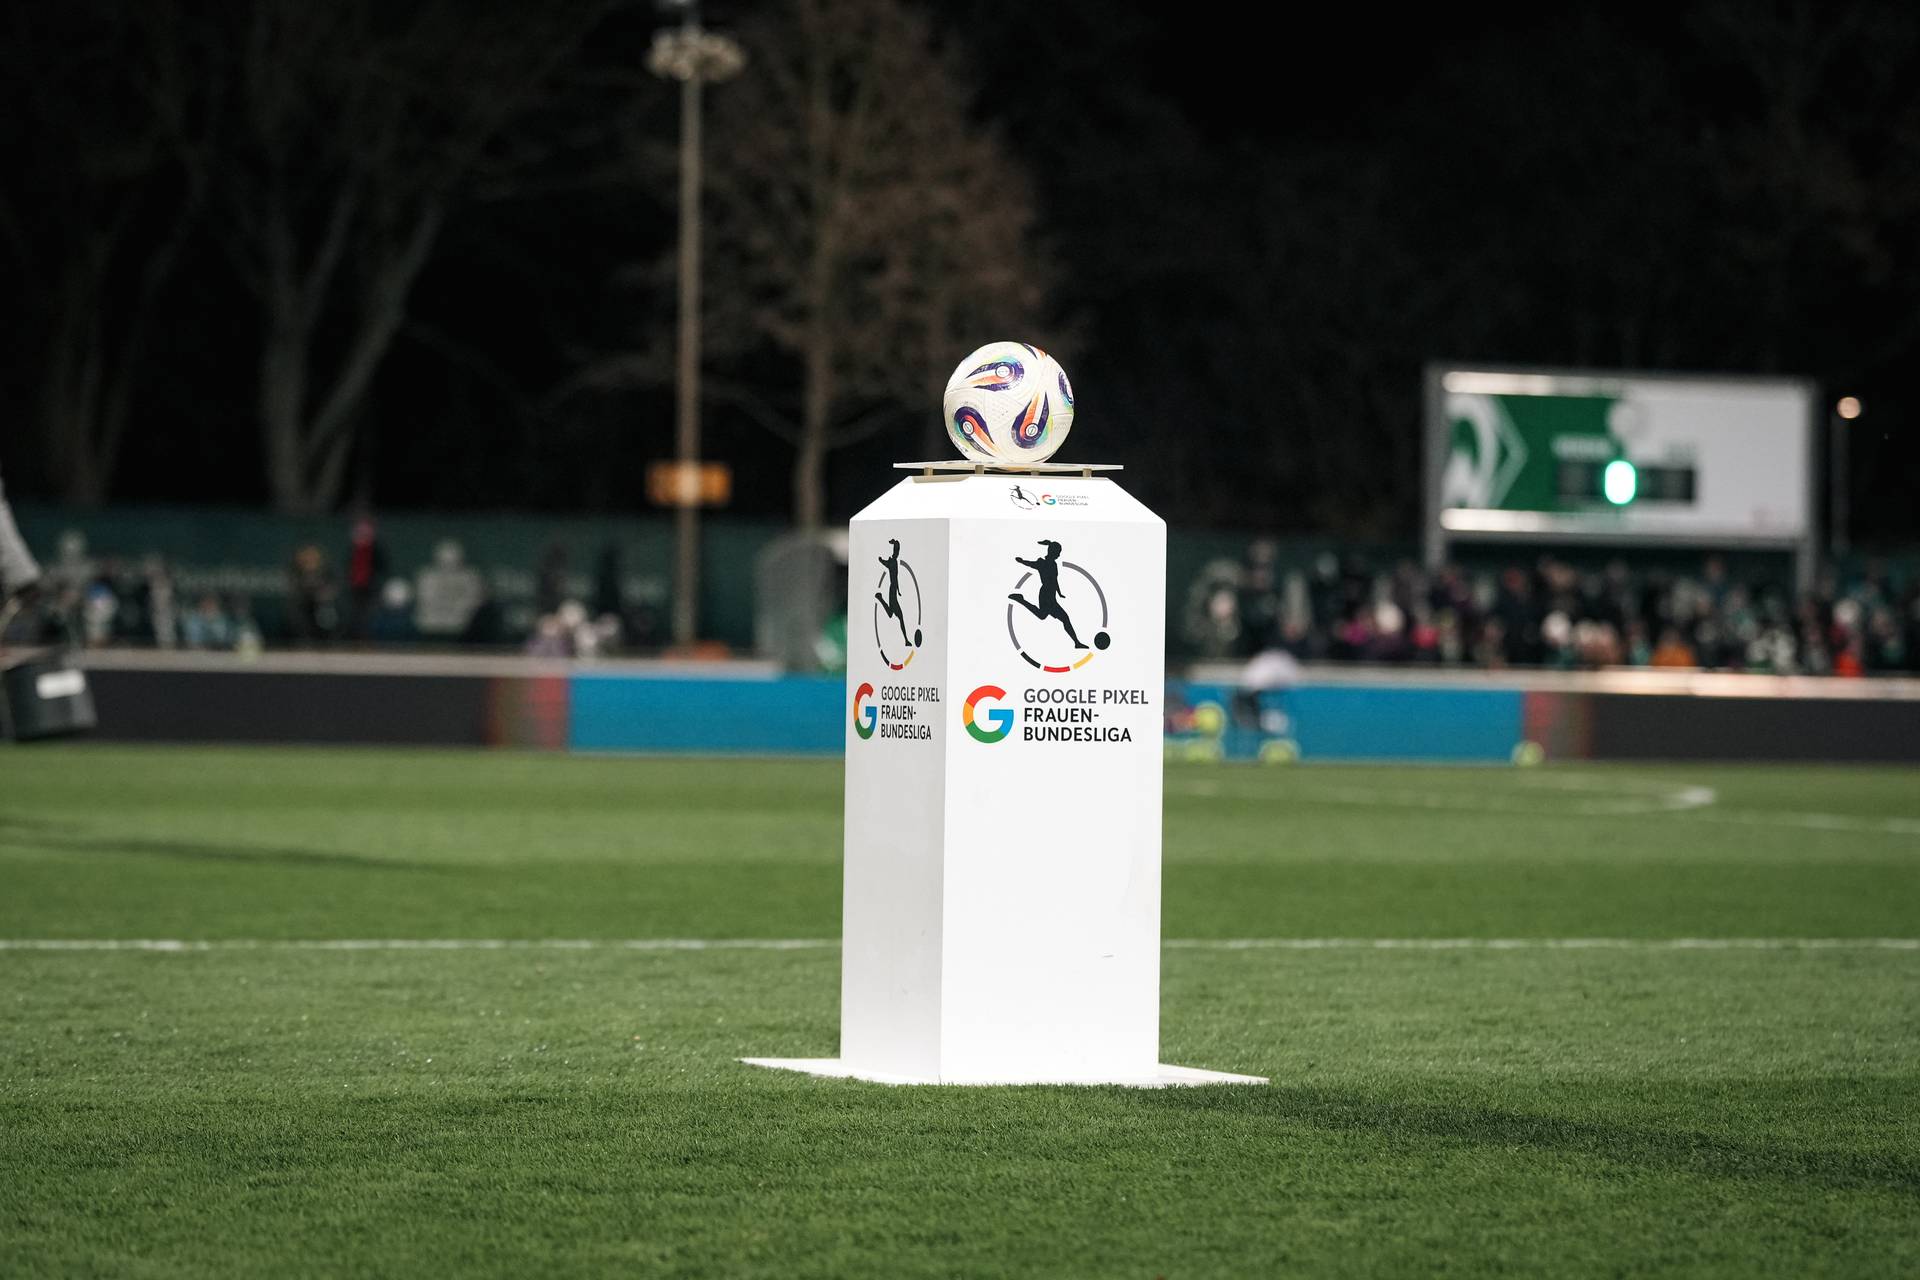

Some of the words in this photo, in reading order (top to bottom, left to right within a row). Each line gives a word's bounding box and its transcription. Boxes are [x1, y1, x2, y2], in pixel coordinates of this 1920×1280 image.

[881, 686, 916, 702] GOOGLE
[918, 686, 940, 703] PIXEL
[1023, 688, 1097, 704] GOOGLE
[1102, 689, 1149, 705] PIXEL
[853, 682, 878, 740] G
[881, 704, 917, 721] FRAUEN-
[962, 684, 1015, 744] G
[1023, 707, 1100, 723] FRAUEN-
[881, 723, 932, 741] BUNDESLIGA
[1023, 726, 1132, 743] BUNDESLIGA
